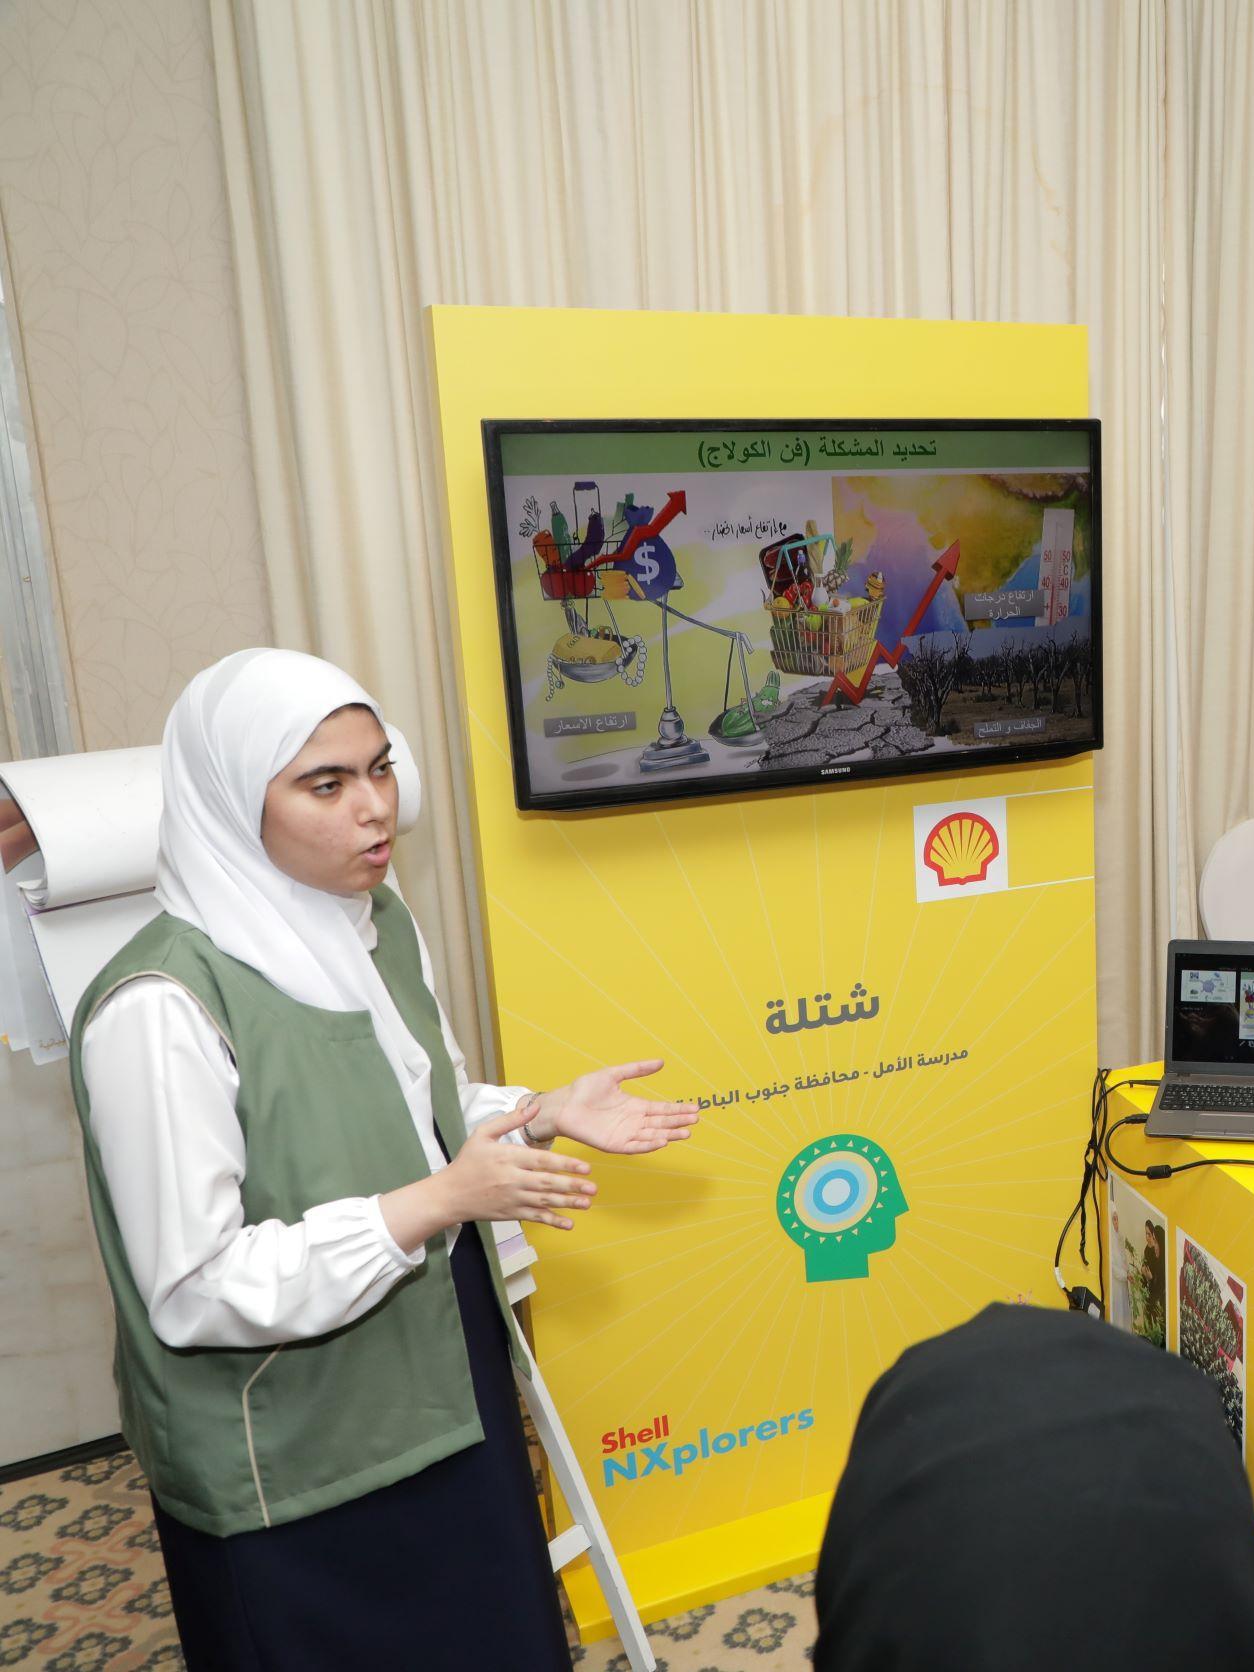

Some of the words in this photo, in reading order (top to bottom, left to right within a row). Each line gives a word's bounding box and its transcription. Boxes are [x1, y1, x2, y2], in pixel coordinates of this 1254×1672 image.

[697, 440, 771, 468] الكولاج)
[780, 437, 811, 467] (فن
[819, 436, 883, 457] المشكلة
[892, 439, 937, 462] تحديد
[736, 515, 753, 539] أسعار
[778, 521, 787, 537] مع
[974, 592, 1006, 604] درجات
[1008, 590, 1034, 605] ارتفاع
[988, 606, 1021, 620] الحرارة
[596, 714, 628, 732] ارتفاع
[820, 766, 851, 775] SAMSUNG
[765, 982, 880, 1034] شتلة
[873, 1055, 913, 1079] الأمل
[917, 1049, 969, 1068] مدرسة
[794, 1068, 860, 1091] محافظة
[676, 1089, 740, 1111] الباط
[745, 1081, 790, 1104] جنوب
[601, 1414, 670, 1454] Shell
[602, 1408, 815, 1487] NXplorers
